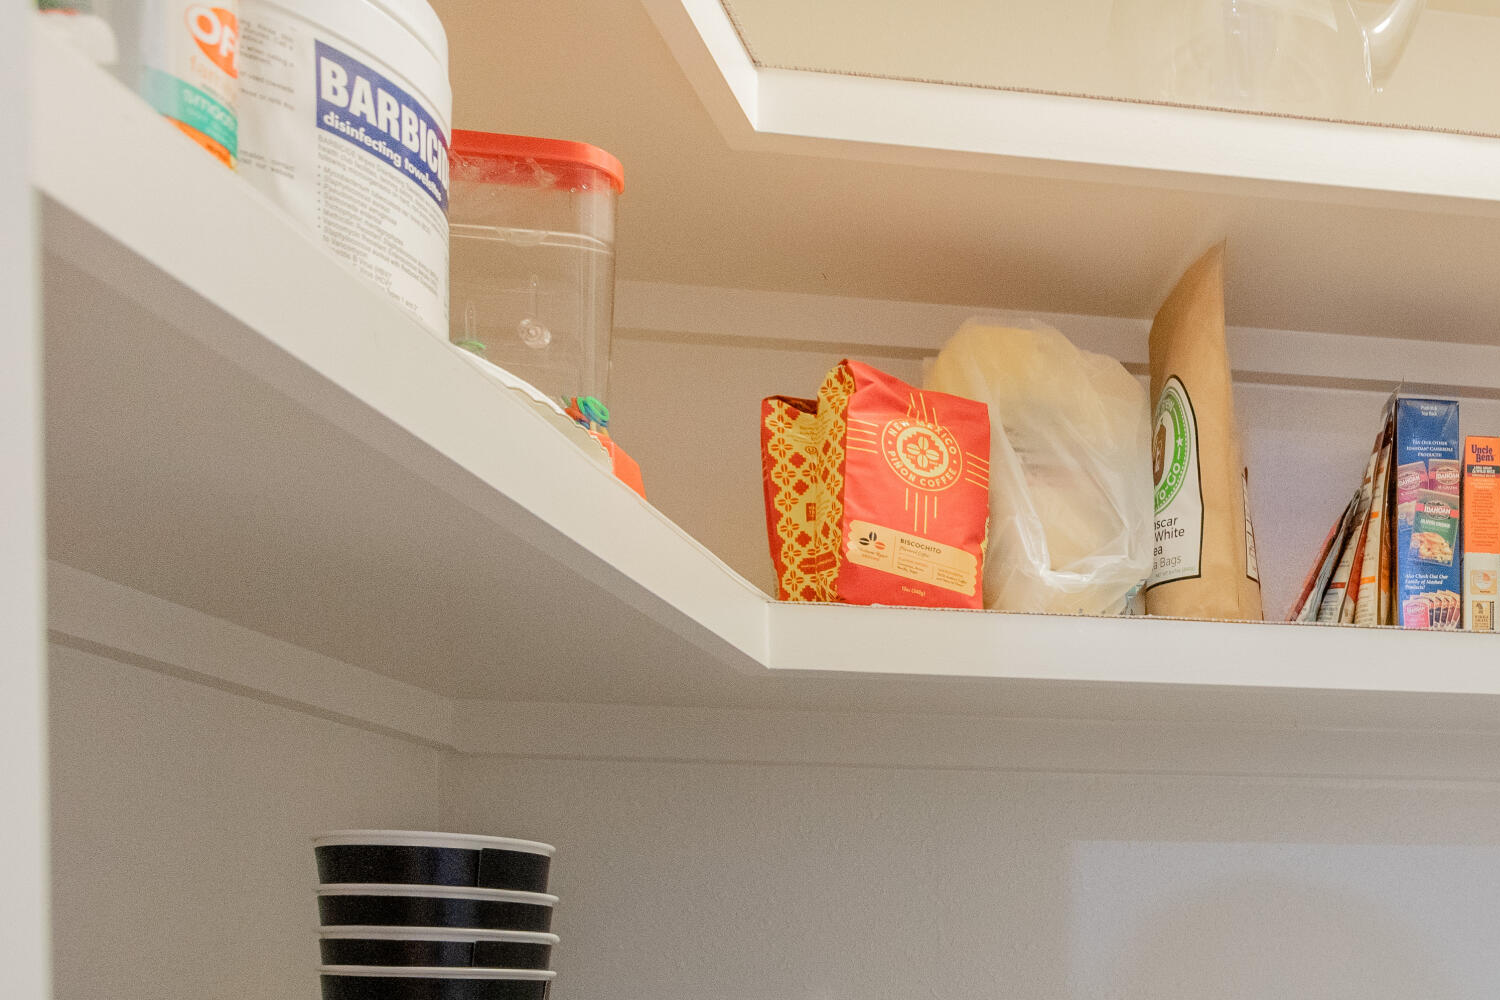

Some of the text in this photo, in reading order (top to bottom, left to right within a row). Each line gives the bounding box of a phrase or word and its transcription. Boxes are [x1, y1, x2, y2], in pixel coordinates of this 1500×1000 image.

[323, 112, 402, 168] disinfecting
[1472, 444, 1493, 455] Uncle
[1475, 453, 1495, 463] Ben's
[919, 467, 958, 487] COFFEE
[1424, 505, 1451, 514] IDAHOAN
[1155, 527, 1185, 543] White
[900, 538, 942, 554] BISCOCHITO
[1159, 556, 1182, 570] Bags
